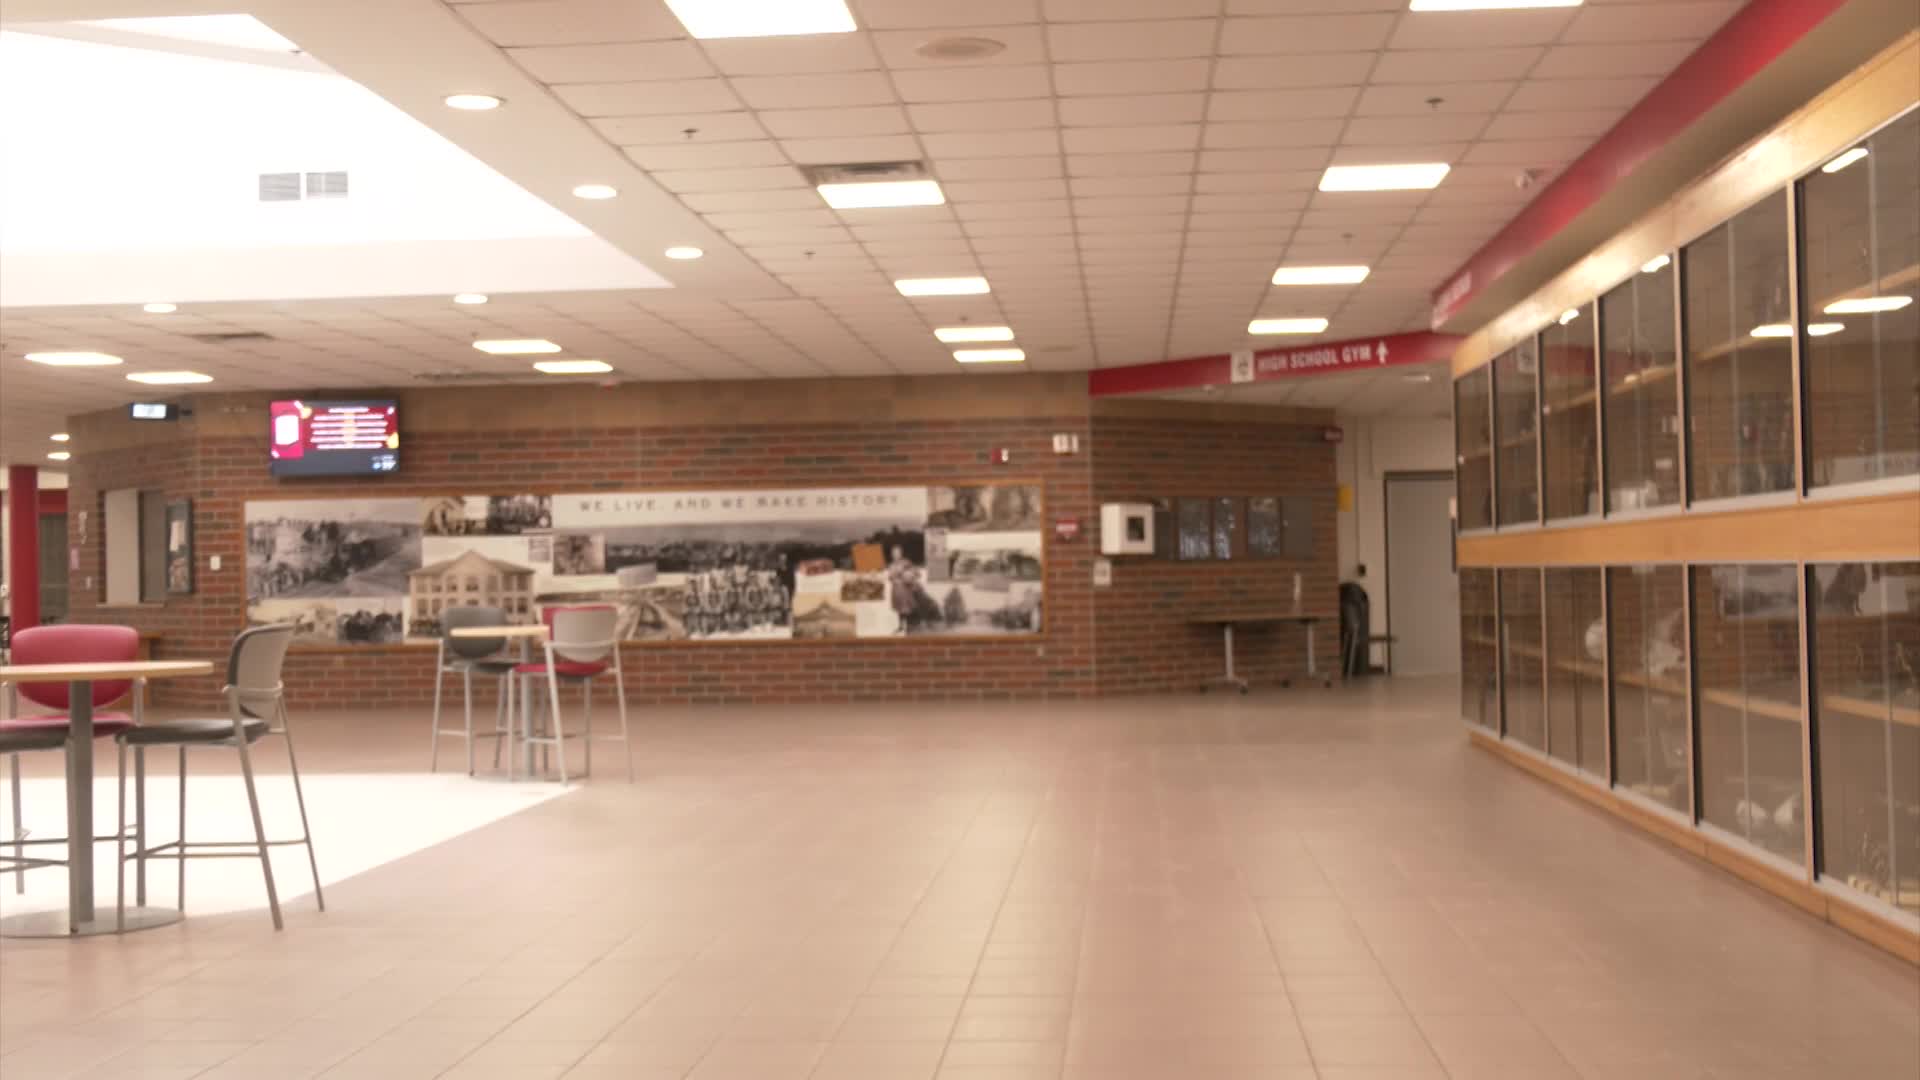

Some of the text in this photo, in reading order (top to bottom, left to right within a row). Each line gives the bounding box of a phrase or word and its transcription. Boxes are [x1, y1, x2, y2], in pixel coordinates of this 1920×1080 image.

[1290, 349, 1339, 369] SCHOOL
[1342, 345, 1372, 363] GYM
[580, 500, 602, 511] WE
[673, 497, 711, 509] AND
[721, 496, 746, 509] WE
[757, 495, 807, 508] MAKE
[815, 493, 899, 506] HISTORY
